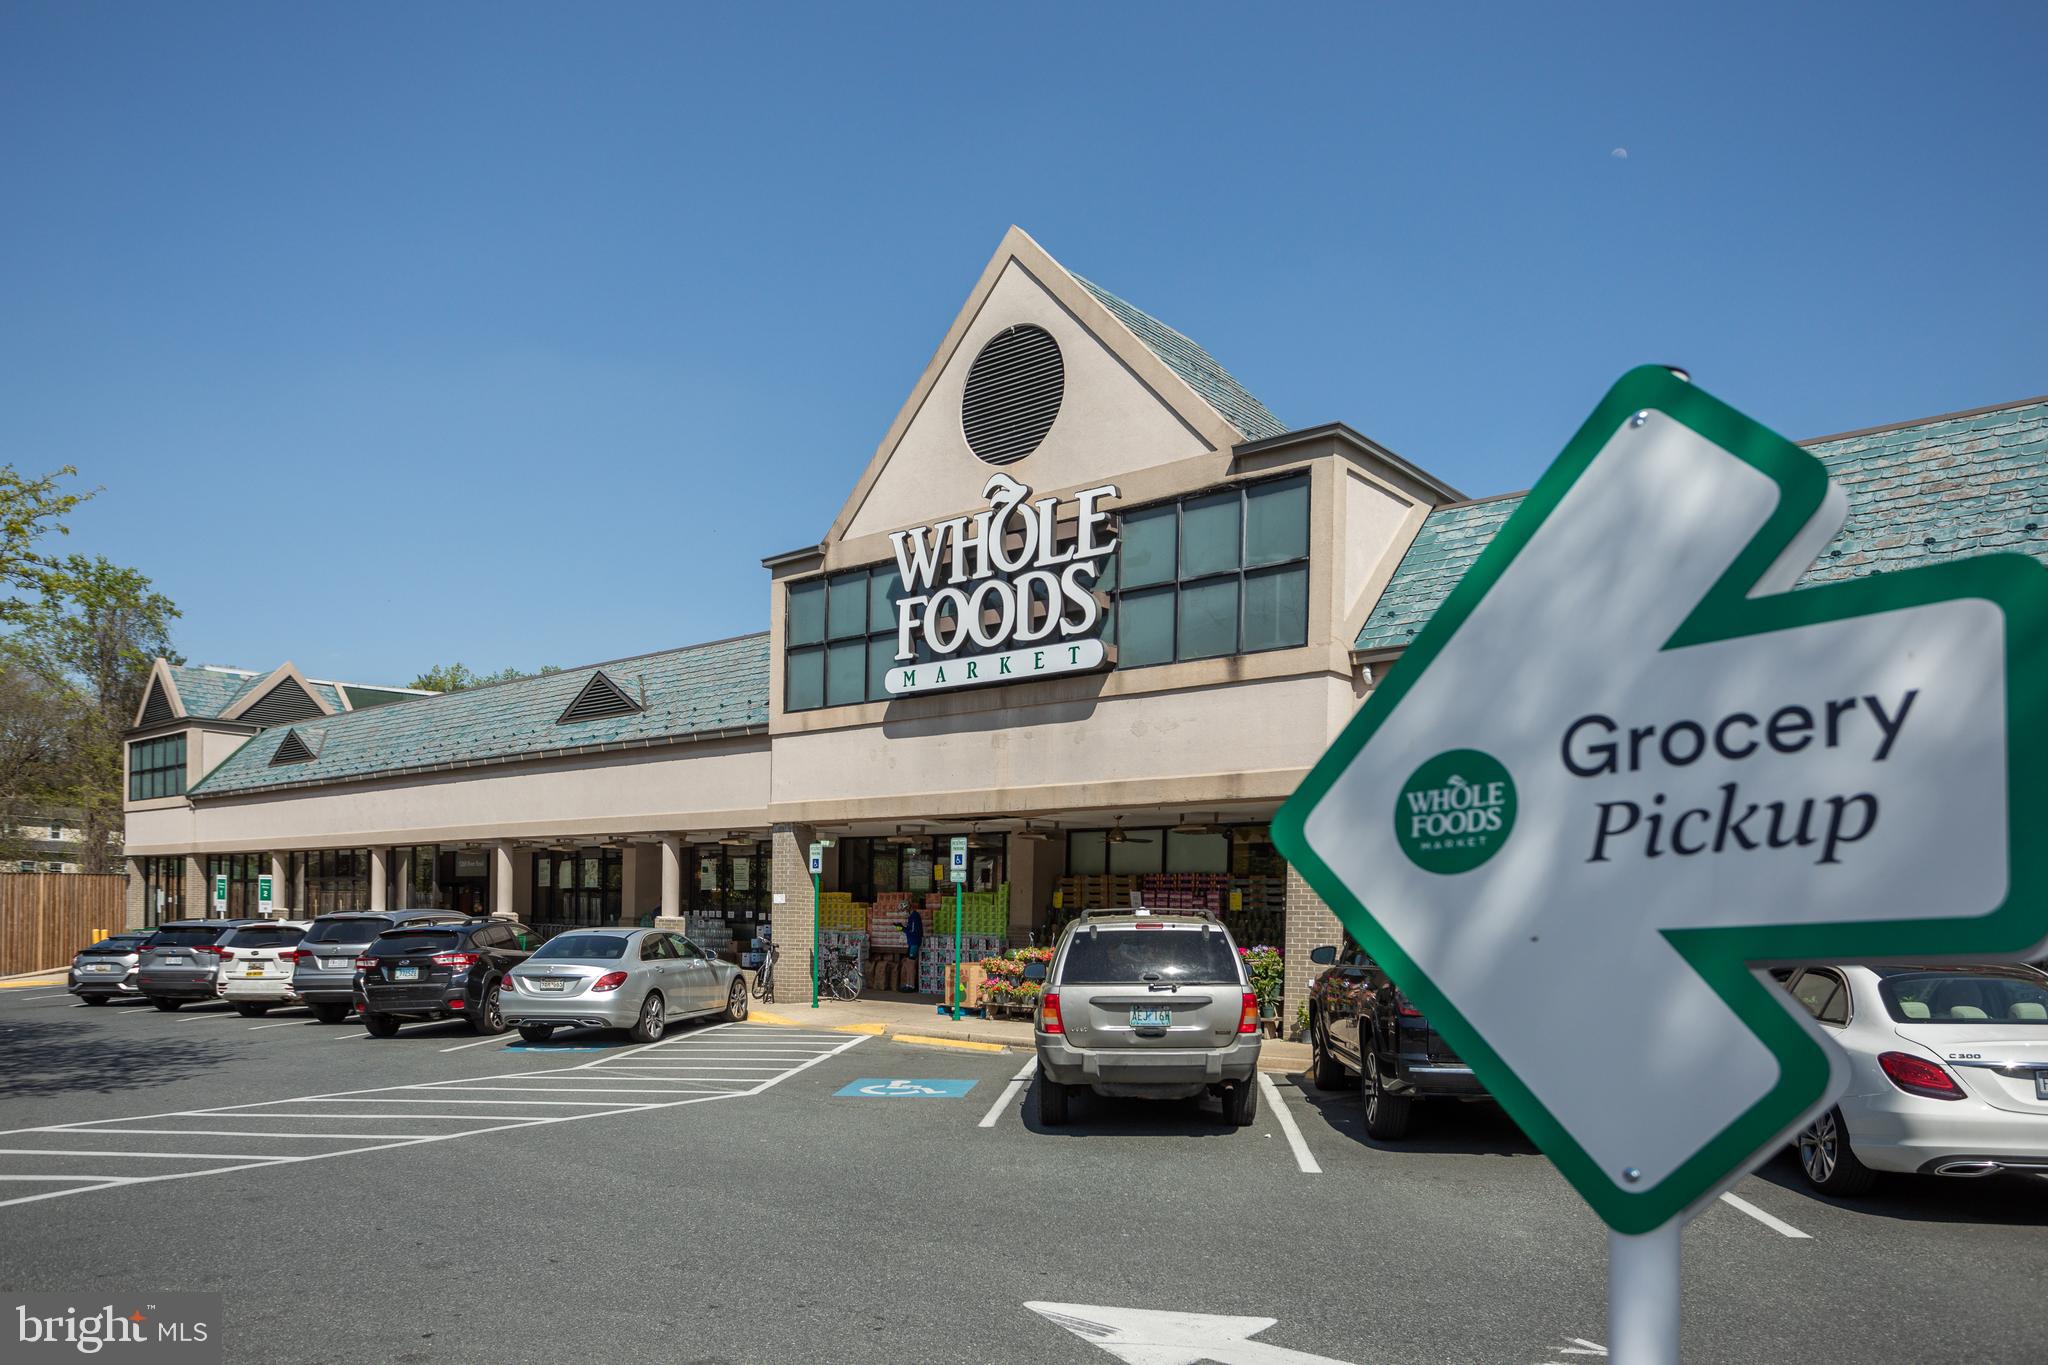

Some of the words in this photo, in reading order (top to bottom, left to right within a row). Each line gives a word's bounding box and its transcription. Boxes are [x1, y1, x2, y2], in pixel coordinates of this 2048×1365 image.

[889, 472, 1120, 592] WHOLE
[894, 560, 1100, 661] FOODS
[903, 645, 1081, 688] MARKET
[1561, 689, 1920, 778] Grocery
[1405, 774, 1505, 814] WHOLE
[1411, 807, 1503, 838] FOODS
[1585, 782, 1880, 865] Pickup
[1420, 836, 1487, 851] MARKET
